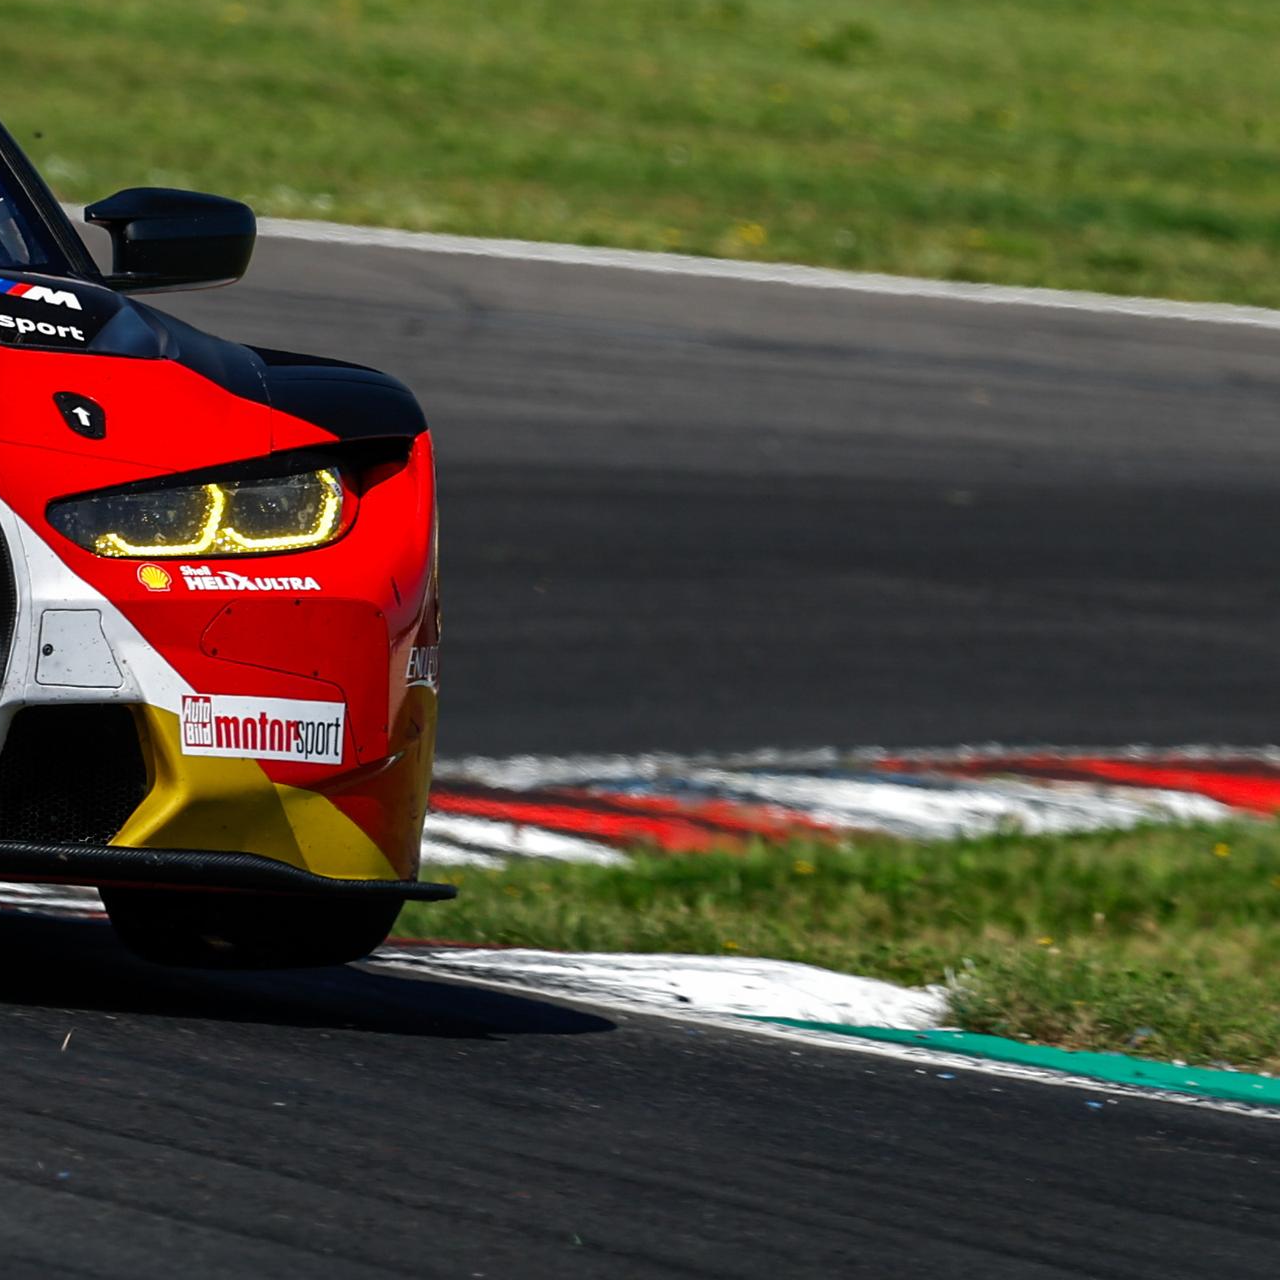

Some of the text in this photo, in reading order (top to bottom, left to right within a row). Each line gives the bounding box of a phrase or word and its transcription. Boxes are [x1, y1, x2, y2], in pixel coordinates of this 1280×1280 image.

[21, 285, 83, 310] M
[180, 565, 212, 577] Shell
[184, 698, 212, 722] Auto
[184, 723, 212, 746] Bild
[214, 712, 341, 759] motorsport
